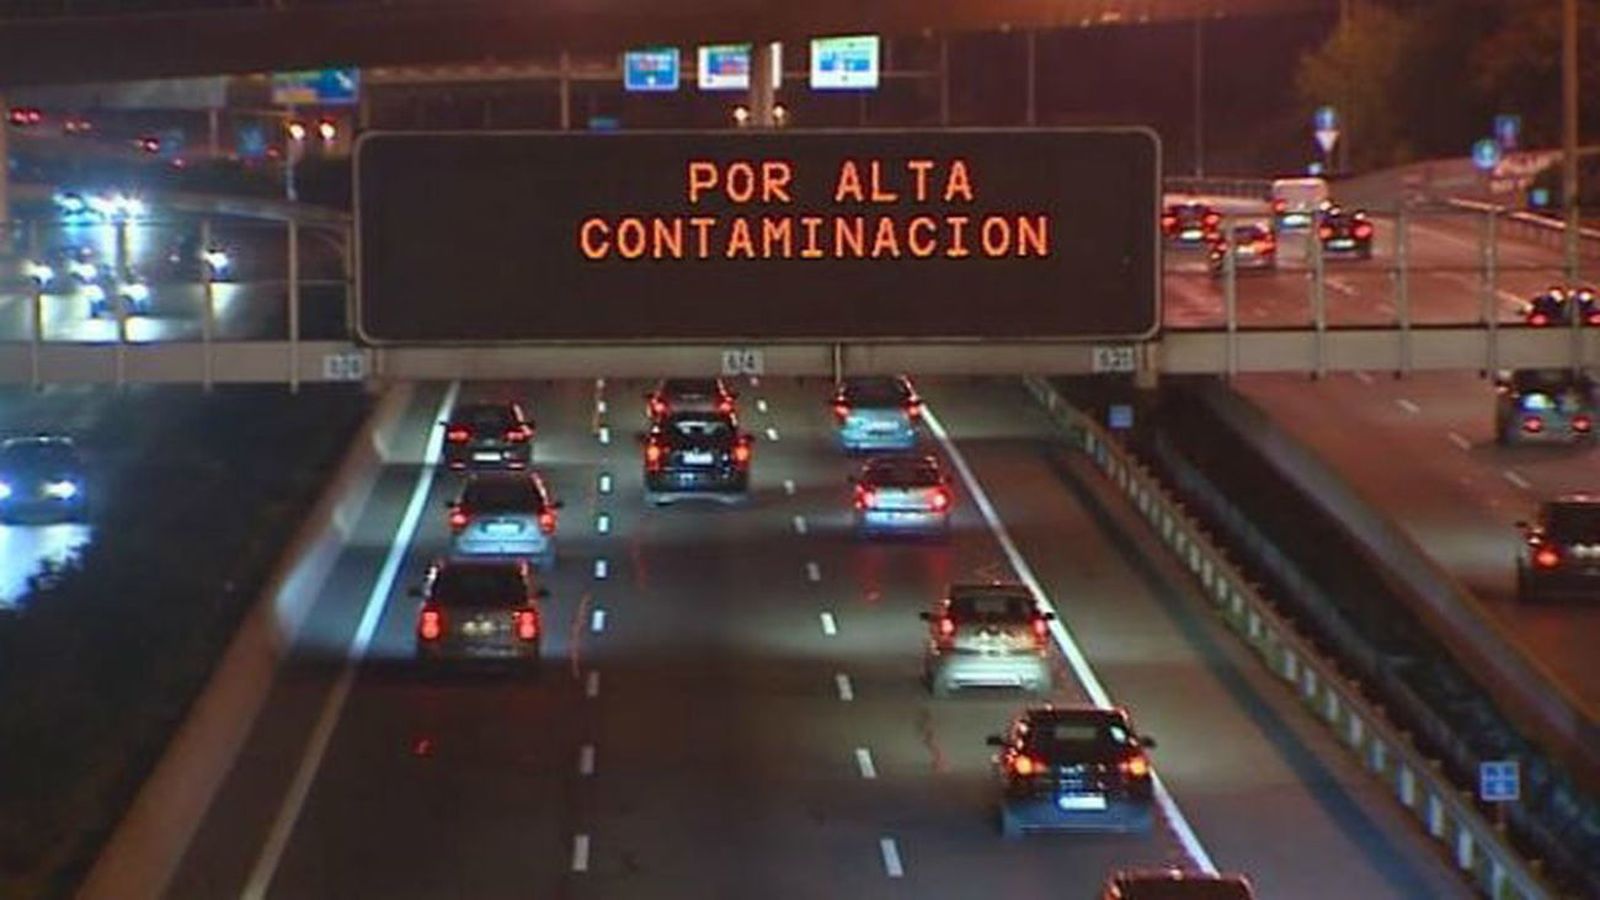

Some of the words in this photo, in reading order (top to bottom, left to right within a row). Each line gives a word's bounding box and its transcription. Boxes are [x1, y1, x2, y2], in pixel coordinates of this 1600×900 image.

[689, 161, 791, 202] POR
[836, 160, 973, 201] ALTA
[581, 216, 1047, 258] CONTAMINACION
